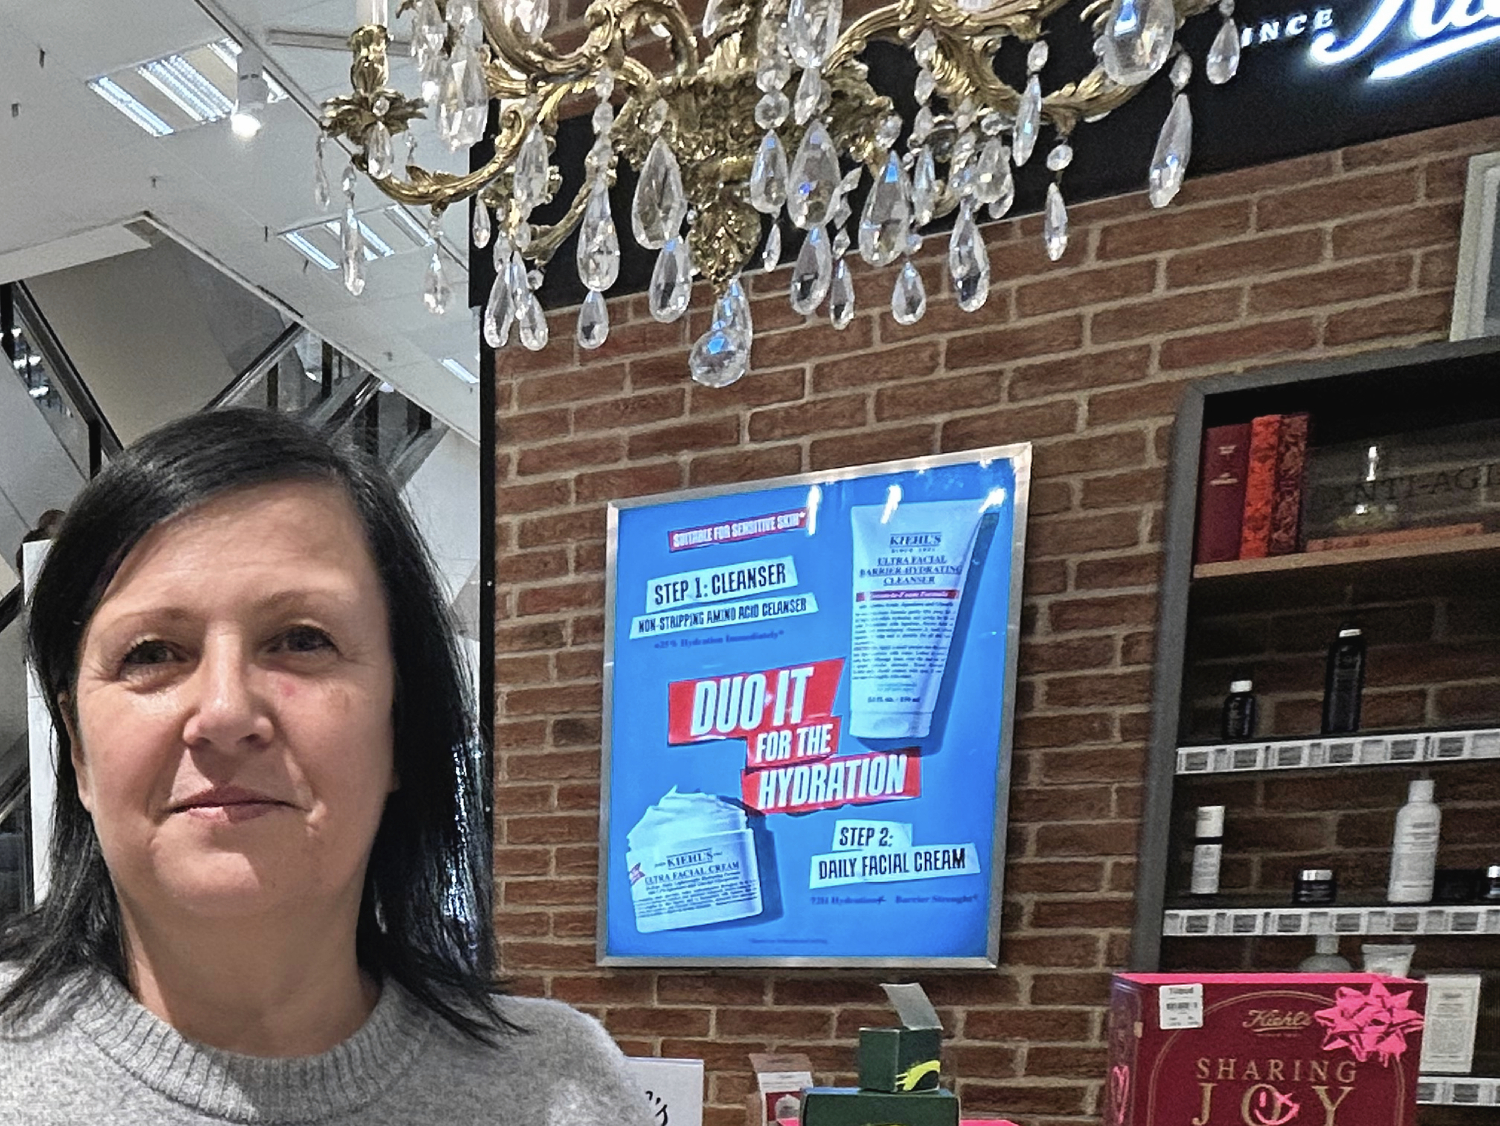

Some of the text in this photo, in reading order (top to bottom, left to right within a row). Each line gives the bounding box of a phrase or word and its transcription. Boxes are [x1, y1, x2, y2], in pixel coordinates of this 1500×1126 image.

[1240, 8, 1333, 48] INCE
[673, 529, 713, 548] SUITABLE
[713, 527, 731, 541] FOR
[732, 517, 776, 537] SENSITIVE
[912, 555, 947, 565] FACIAL
[654, 562, 786, 605] STEP 1: CLEANSER
[637, 598, 807, 634] NON-STRIPPING AMINO ACID CELANSER
[680, 636, 723, 649] Hydration
[690, 666, 815, 736] DUO IT
[755, 723, 834, 764] FOR THE
[757, 753, 908, 810] HYDRATION
[839, 827, 894, 847] STEP 2:
[644, 861, 740, 886] ULTRA FACIAL CREAM
[667, 851, 713, 867] KIEHL'S
[818, 848, 966, 880] DAILY FACIAL CREAM
[1242, 1009, 1313, 1029] Kiehl's
[1197, 1057, 1357, 1084] SHARING
